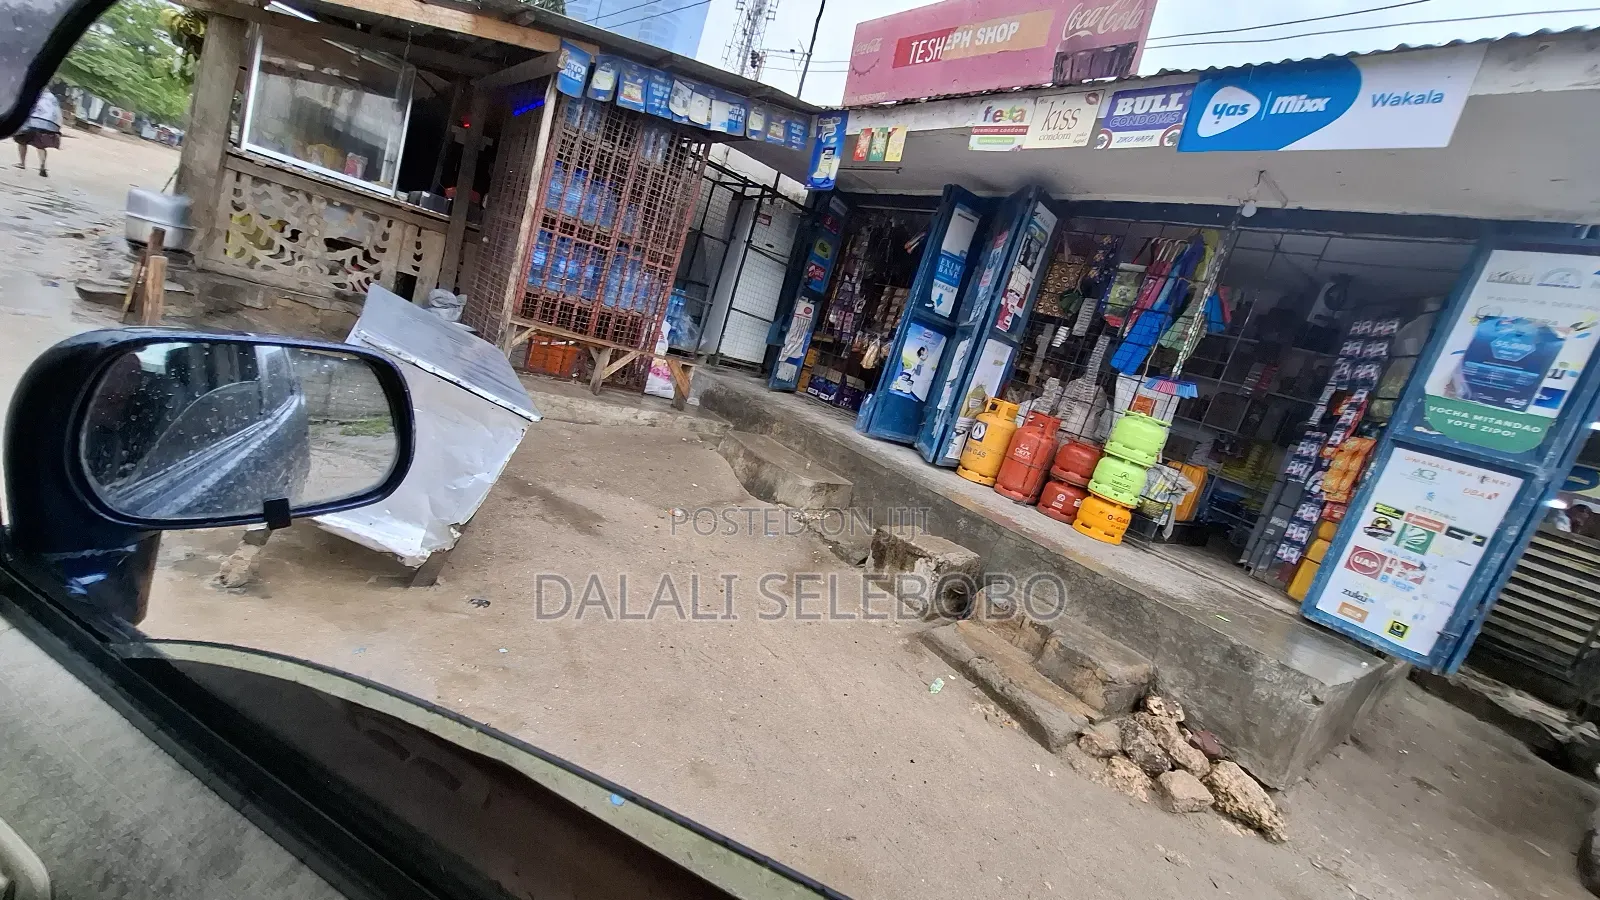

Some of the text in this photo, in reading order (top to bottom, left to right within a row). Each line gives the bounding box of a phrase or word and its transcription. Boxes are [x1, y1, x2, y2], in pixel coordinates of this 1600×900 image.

[976, 22, 1020, 46] SHOP
[1113, 92, 1184, 116] BULL
[1371, 90, 1445, 108] Wakala
[1041, 100, 1081, 132] kiss
[1110, 112, 1180, 127] CONDOMS
[999, 126, 1027, 134] condoms
[1038, 132, 1072, 141] condom
[1429, 405, 1542, 434] VOCHA MITANDAO
[1446, 418, 1518, 438] YOTE ZIPO!
[1353, 555, 1378, 568] UAP
[1341, 588, 1369, 603] zuku
